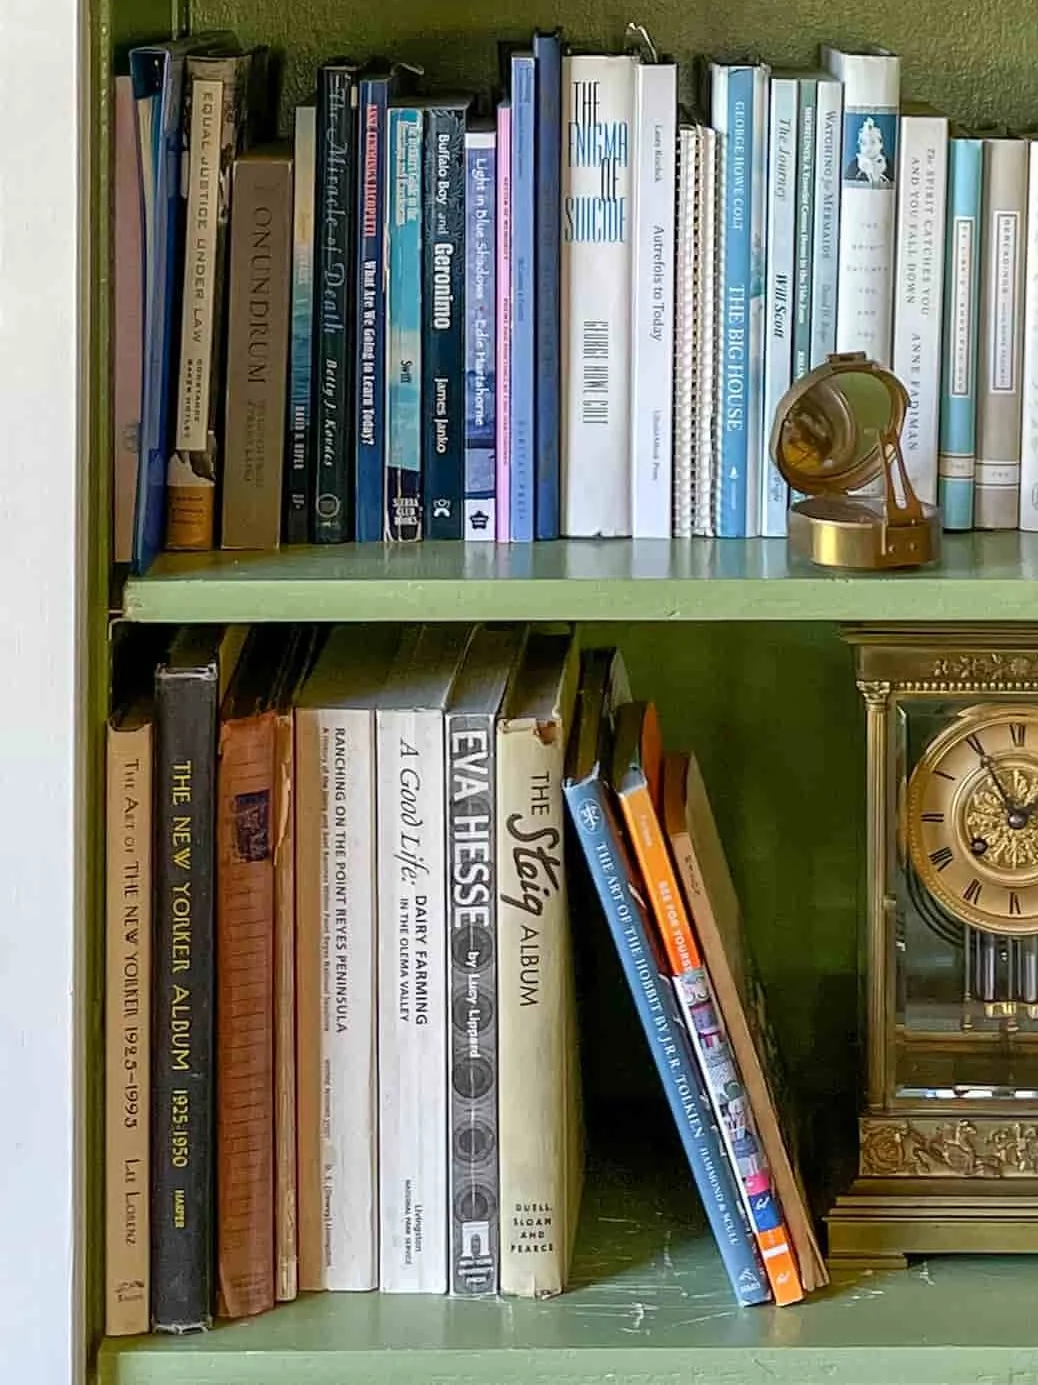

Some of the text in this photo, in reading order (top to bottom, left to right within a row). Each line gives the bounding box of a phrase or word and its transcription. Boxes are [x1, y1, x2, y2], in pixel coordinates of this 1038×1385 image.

[432, 134, 454, 453] Buffalo Boy and Geronimo James Janko
[727, 285, 745, 431] THE BIG HOUSE
[773, 272, 788, 339] Will Scott
[393, 738, 431, 887] A Good Life:
[451, 728, 492, 1059] EVA HESSE by Lucy Lippard
[501, 771, 568, 1008] THE Steig ALBUM
[171, 760, 192, 1168] THE NEW YORKER ALBUM 1925-1950
[413, 895, 429, 1026] DAIRY FARMING
[595, 842, 704, 1139] THE ART OF THE HOBBIT BY J.R.R. TOLKIEN
